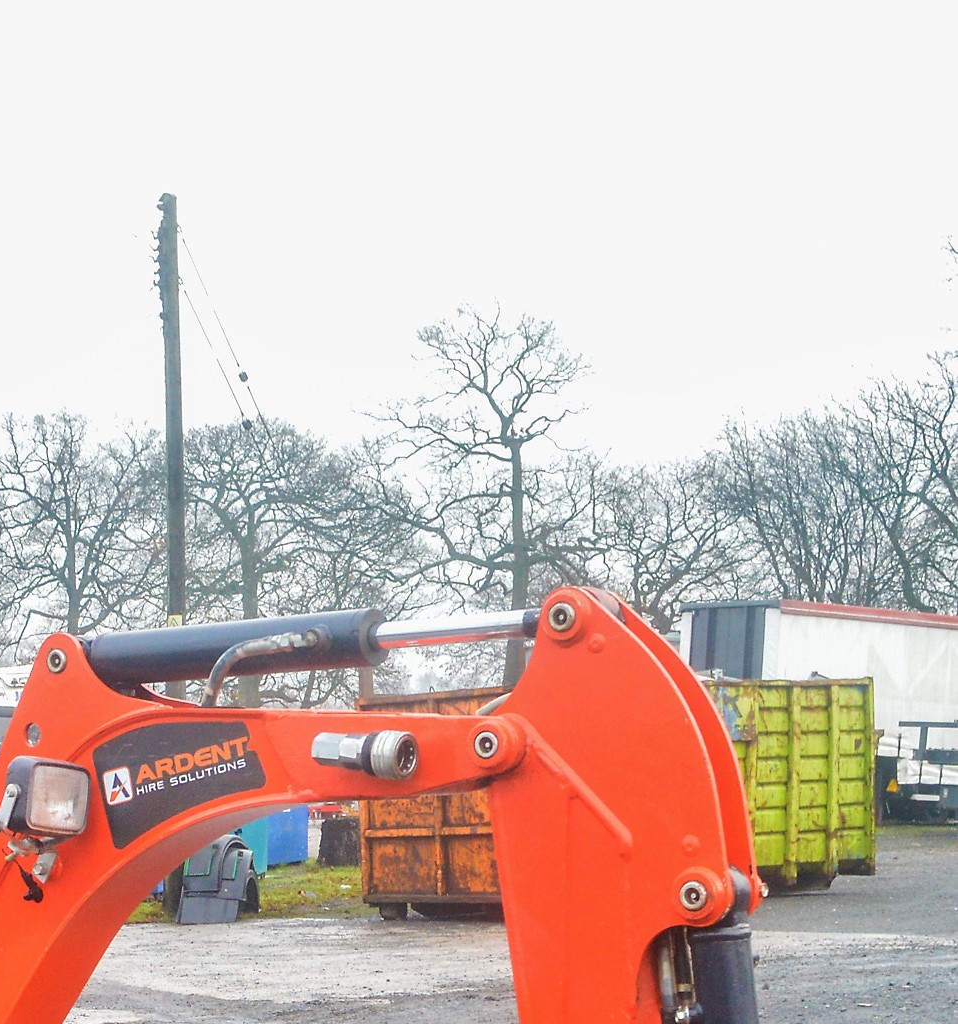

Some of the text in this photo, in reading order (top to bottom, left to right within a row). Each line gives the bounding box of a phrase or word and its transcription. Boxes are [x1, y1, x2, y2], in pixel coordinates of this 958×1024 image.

[136, 736, 250, 785] ARDENT
[136, 758, 247, 796] HIRE SOLUTIONS
